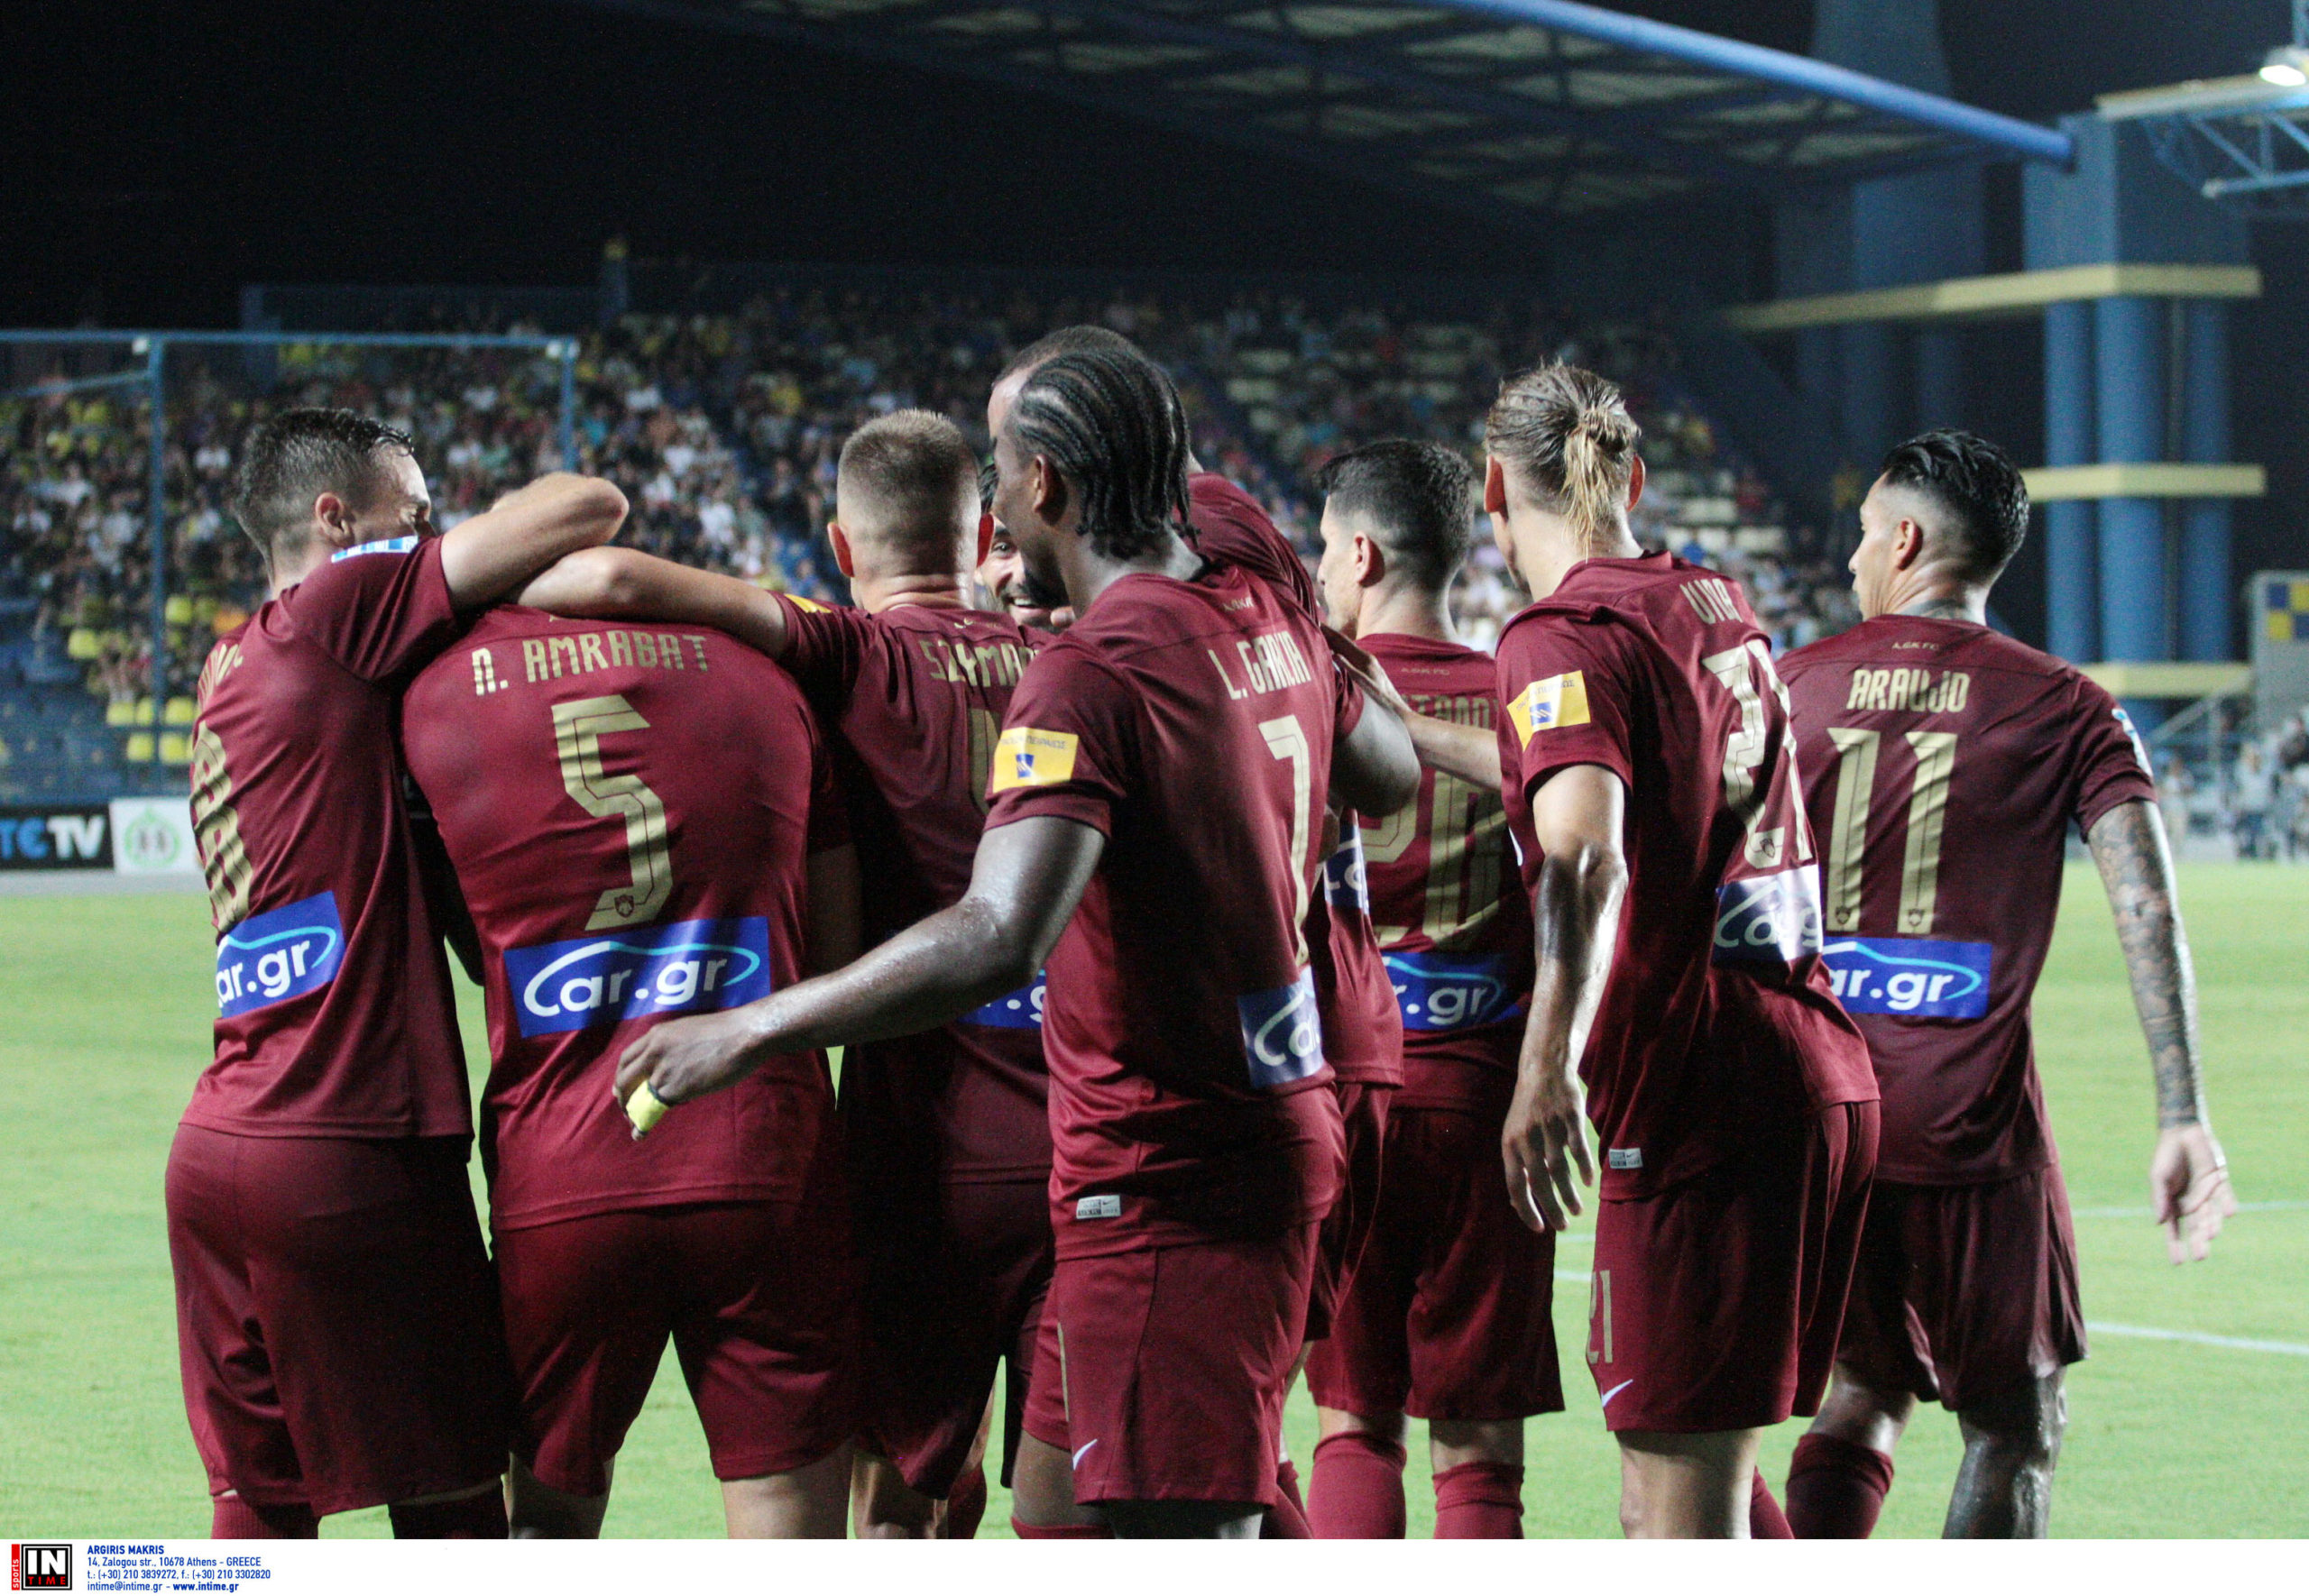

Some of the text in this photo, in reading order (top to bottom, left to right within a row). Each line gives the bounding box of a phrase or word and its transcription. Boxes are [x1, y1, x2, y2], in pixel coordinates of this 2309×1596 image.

[522, 630, 708, 683] AMRABAT
[1846, 667, 1971, 713] ARAUJO
[551, 693, 673, 931] 5
[1257, 714, 1311, 968] 7
[1826, 727, 1958, 934] 11
[216, 940, 311, 1008] ar.gr
